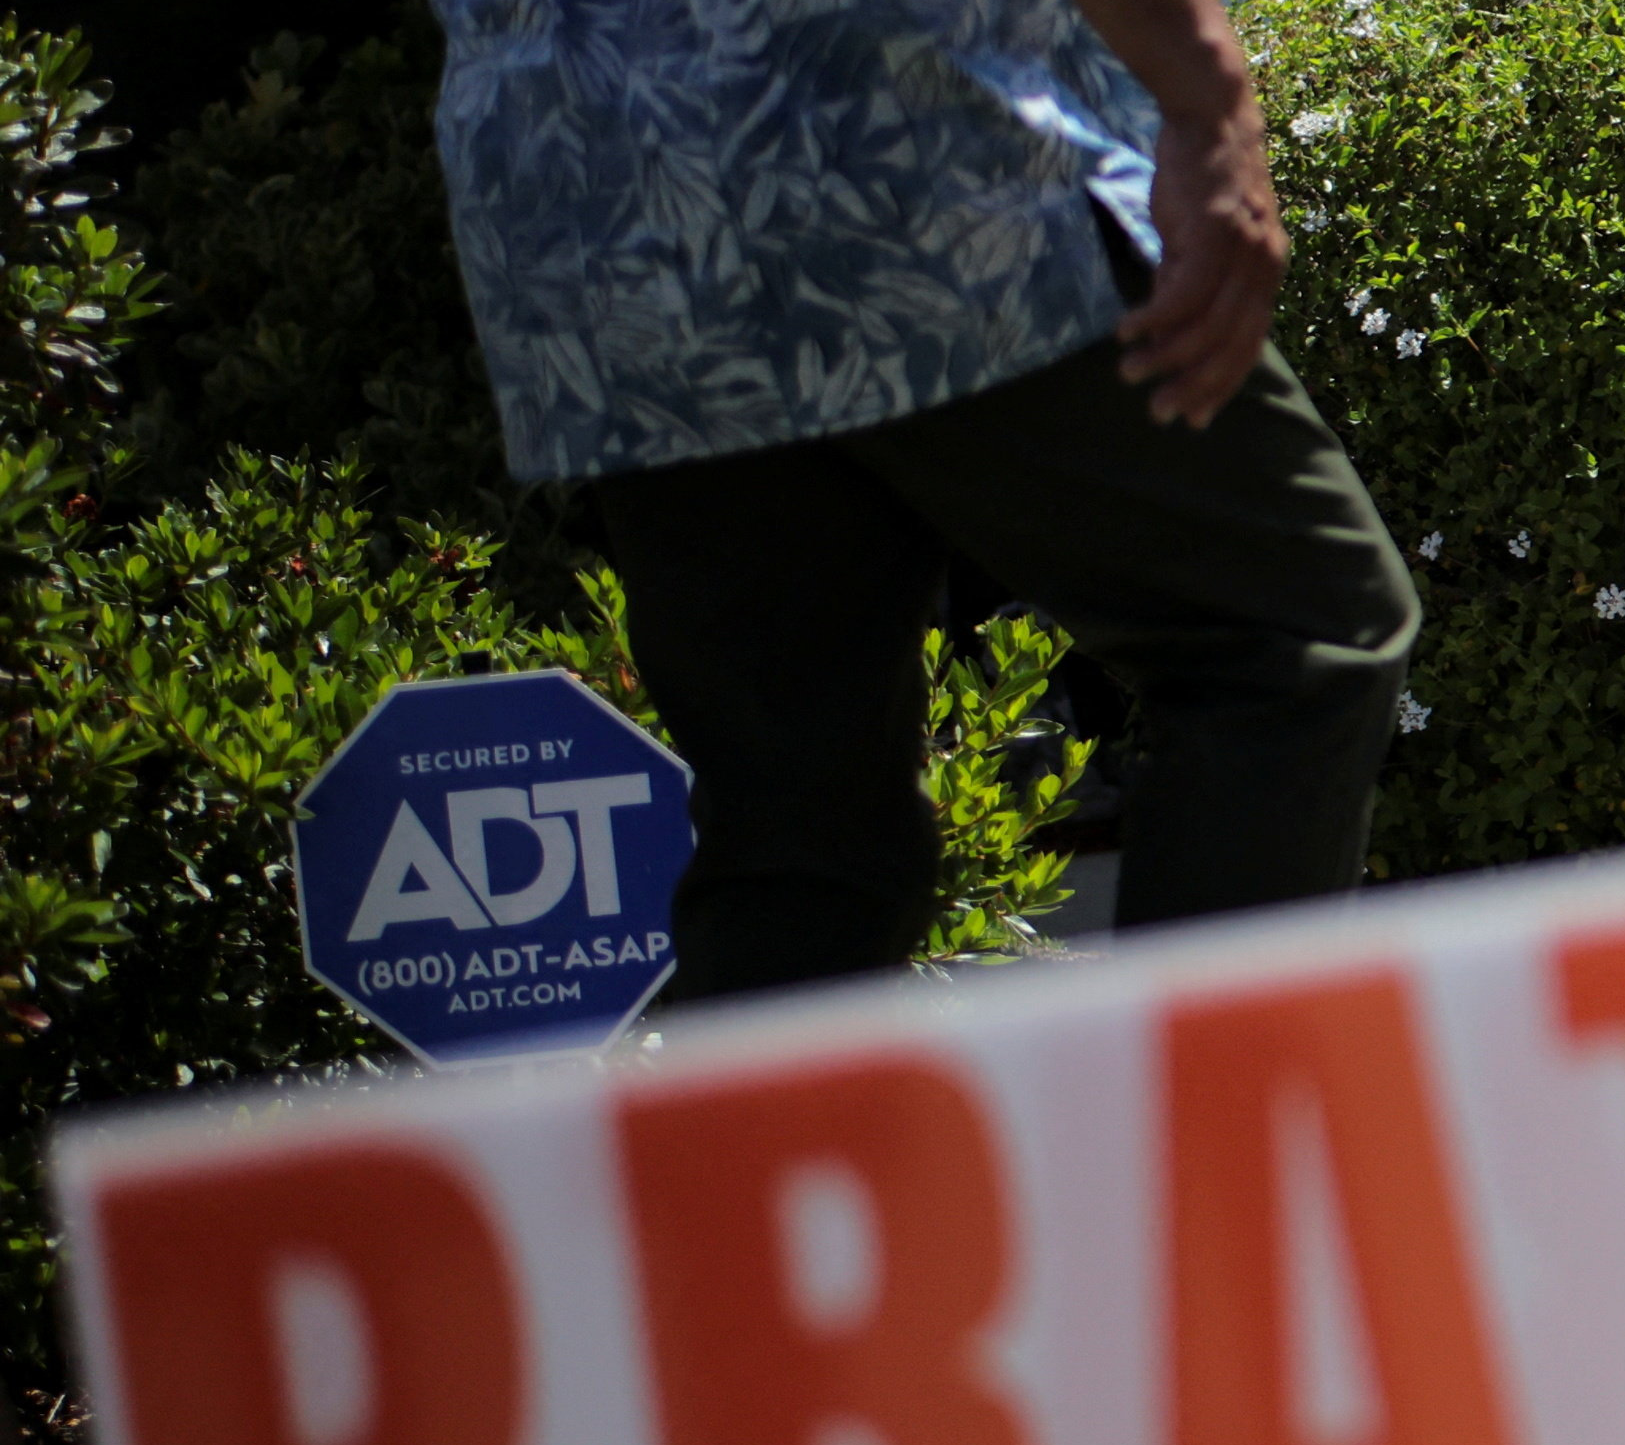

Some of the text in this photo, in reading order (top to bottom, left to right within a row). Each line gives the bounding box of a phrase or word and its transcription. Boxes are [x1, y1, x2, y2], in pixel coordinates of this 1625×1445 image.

[400, 739, 574, 775] SECURED BY
[346, 772, 653, 943] ADT
[357, 931, 671, 996] (800) ADT-ASAP
[447, 981, 582, 1015] ADT.COM
